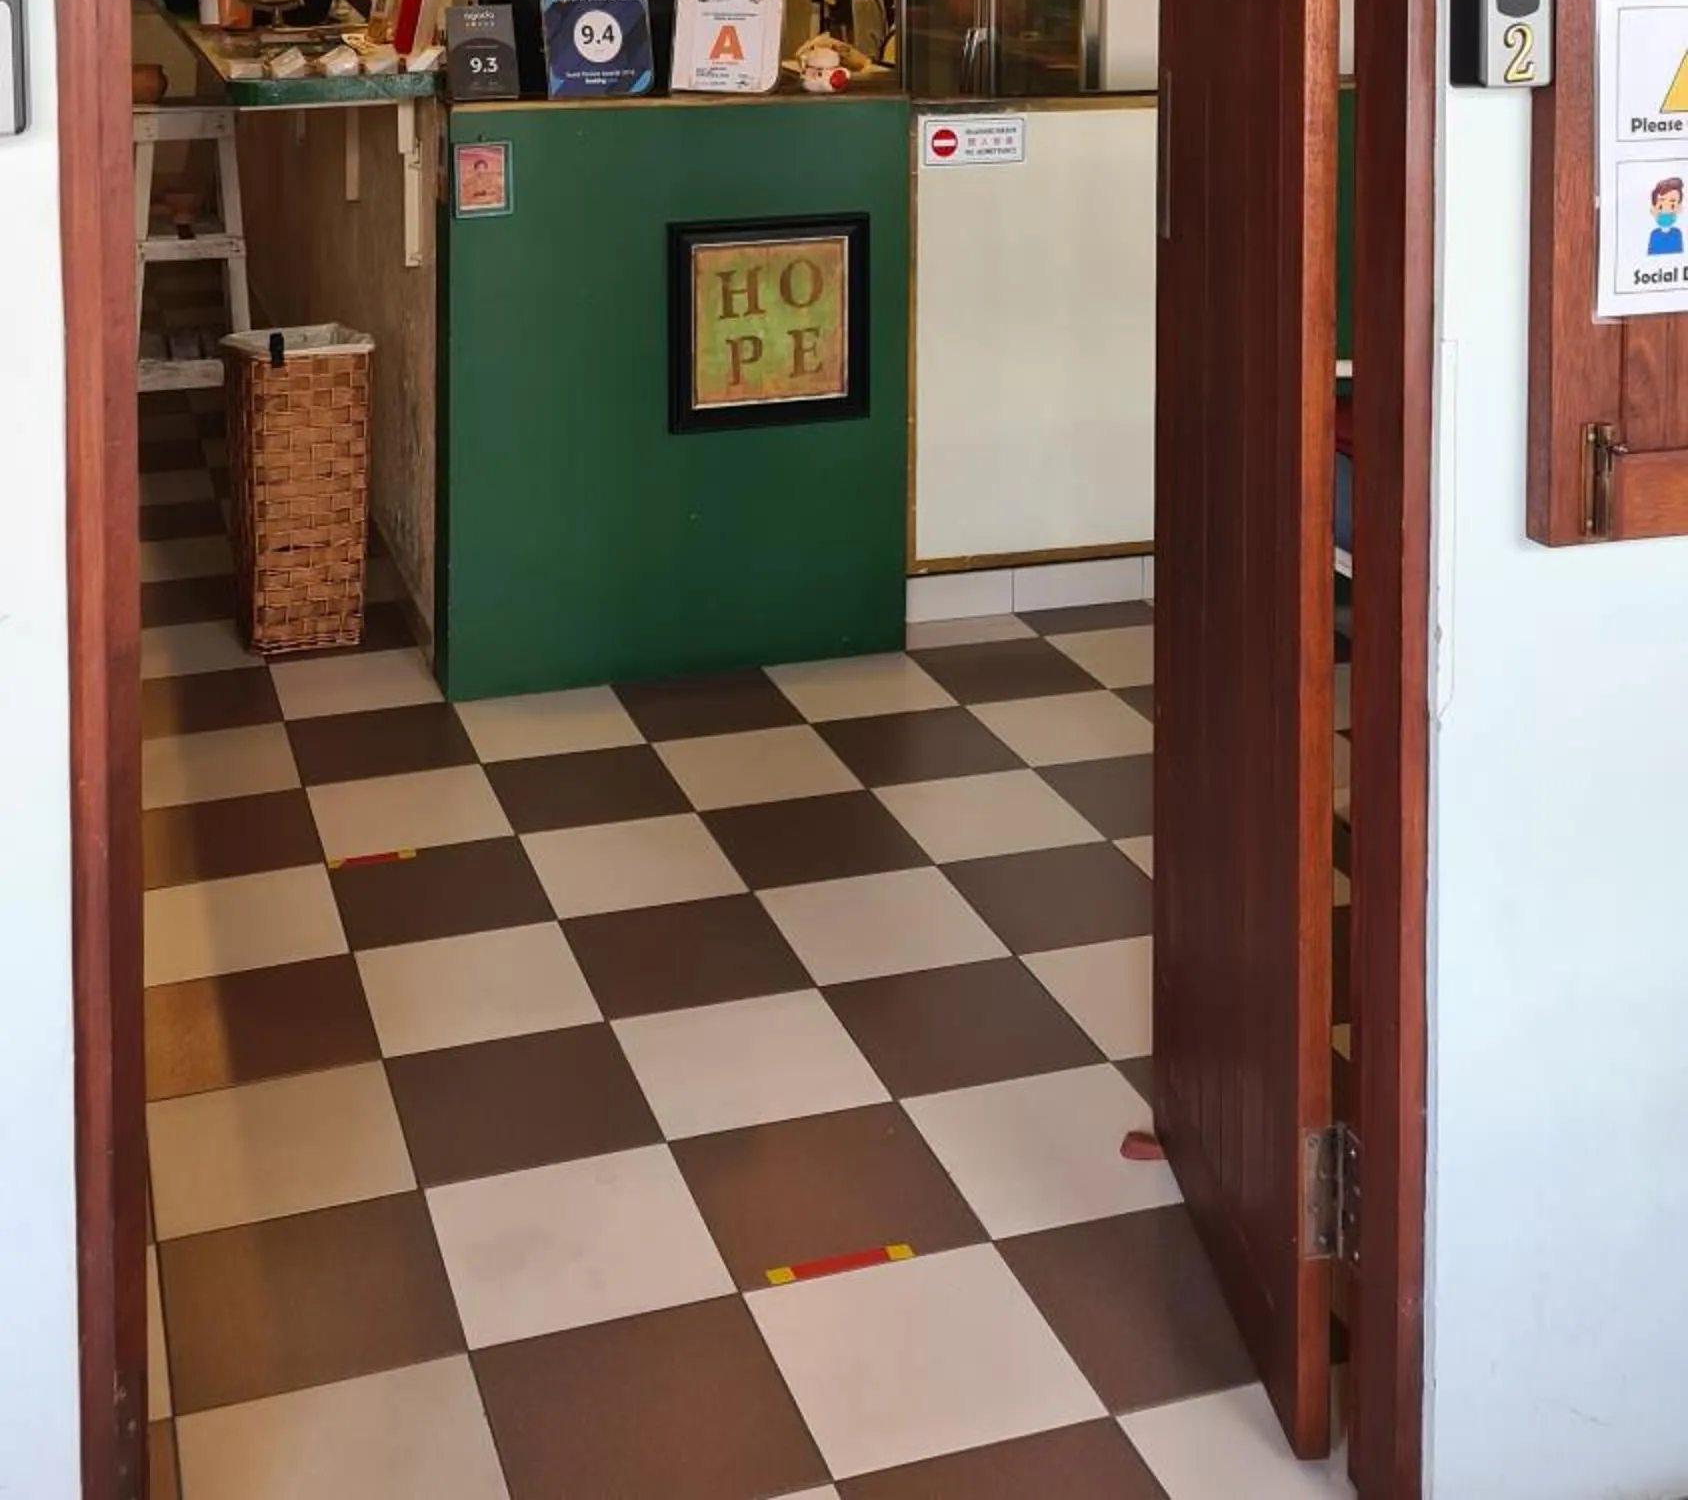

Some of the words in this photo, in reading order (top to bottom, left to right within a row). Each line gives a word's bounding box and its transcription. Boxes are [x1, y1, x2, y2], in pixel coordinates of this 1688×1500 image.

[581, 24, 616, 45] 9.4
[709, 25, 744, 60] A
[1503, 22, 1535, 83] 2
[469, 57, 499, 73] 9.3
[1630, 117, 1683, 133] Please
[1633, 267, 1679, 285] Social
